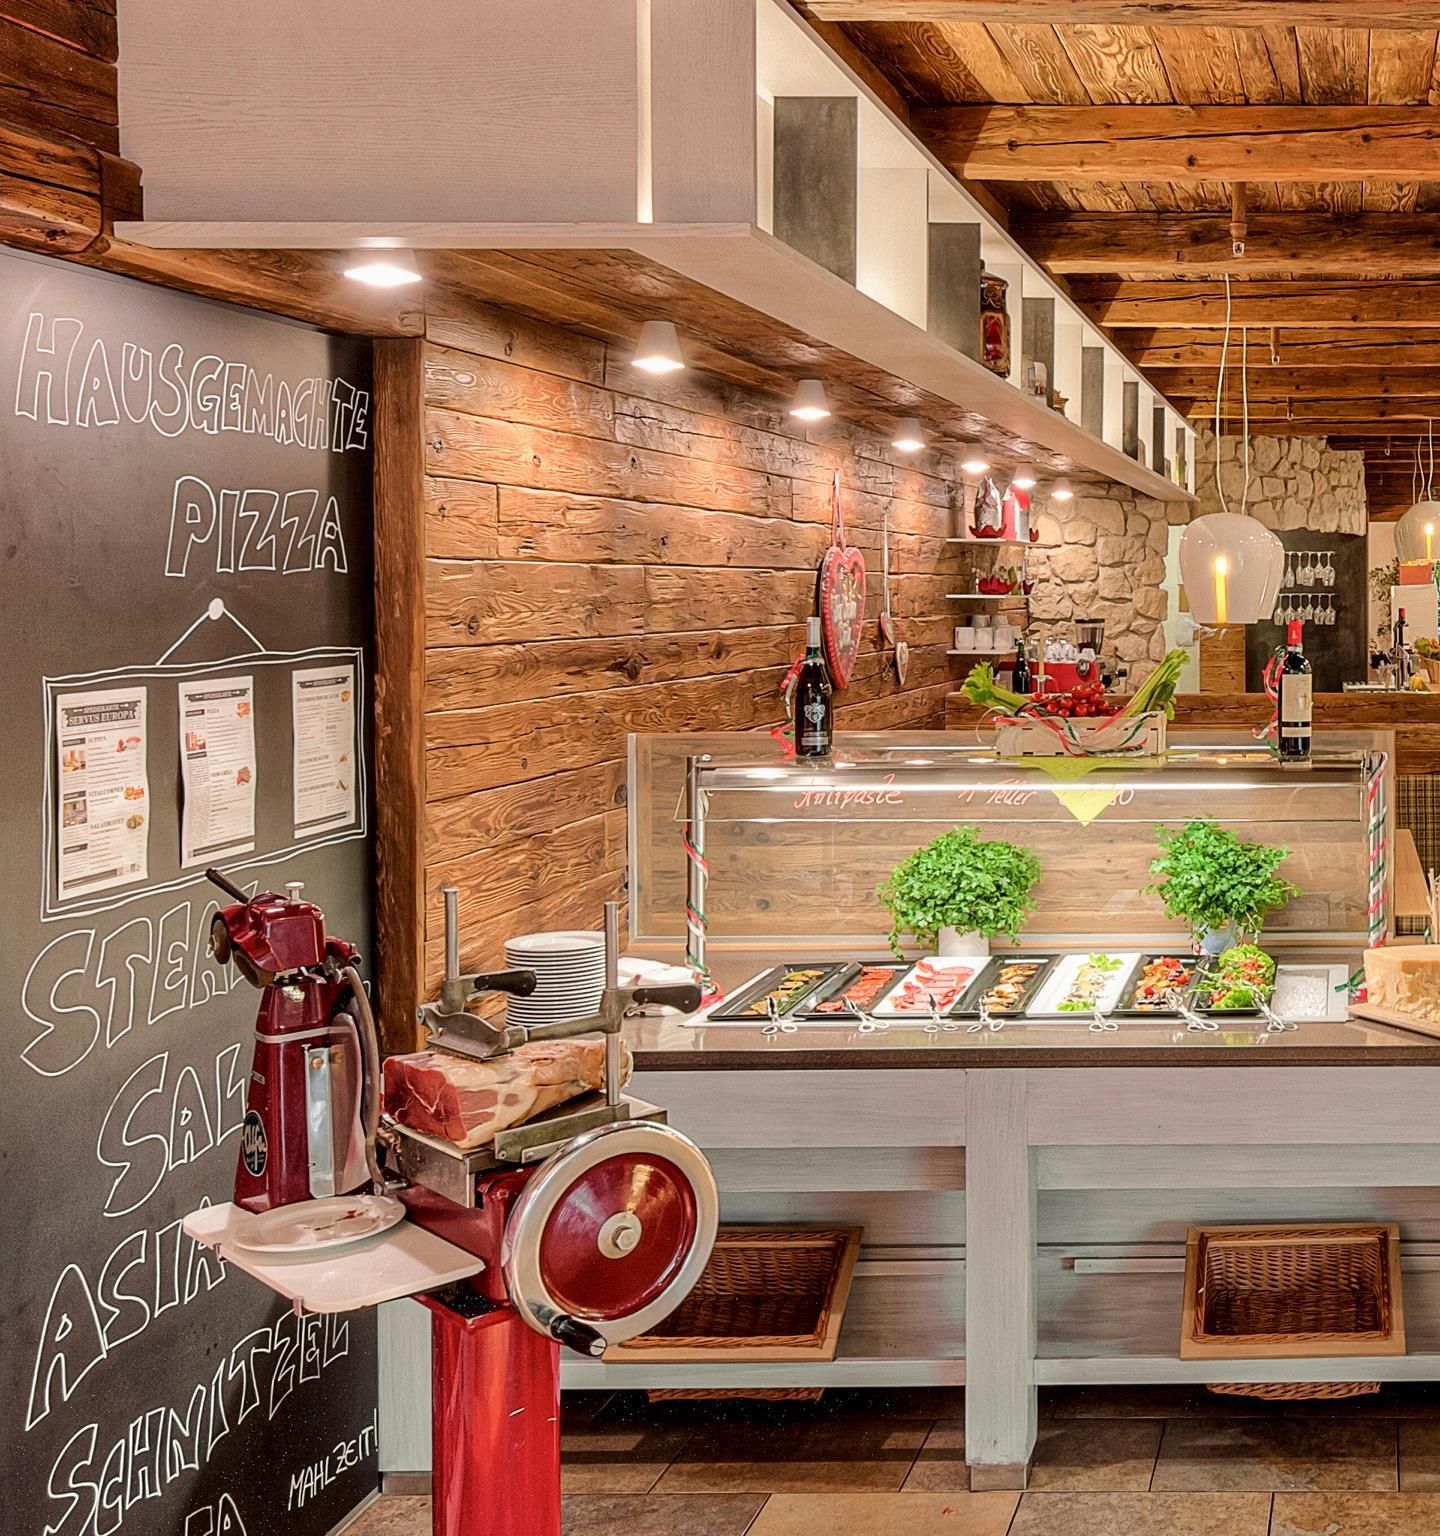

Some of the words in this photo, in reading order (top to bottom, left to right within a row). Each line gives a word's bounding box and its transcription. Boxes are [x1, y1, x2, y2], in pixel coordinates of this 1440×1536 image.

[15, 312, 369, 454] HAUSGEMACHTE
[164, 475, 348, 578] PIZZA
[68, 712, 101, 727] SERVUS
[101, 709, 135, 722] EUROPA
[20, 881, 262, 1077] STEA
[96, 1043, 248, 1218] SAL
[43, 1307, 350, 1536] SCHNITZEL
